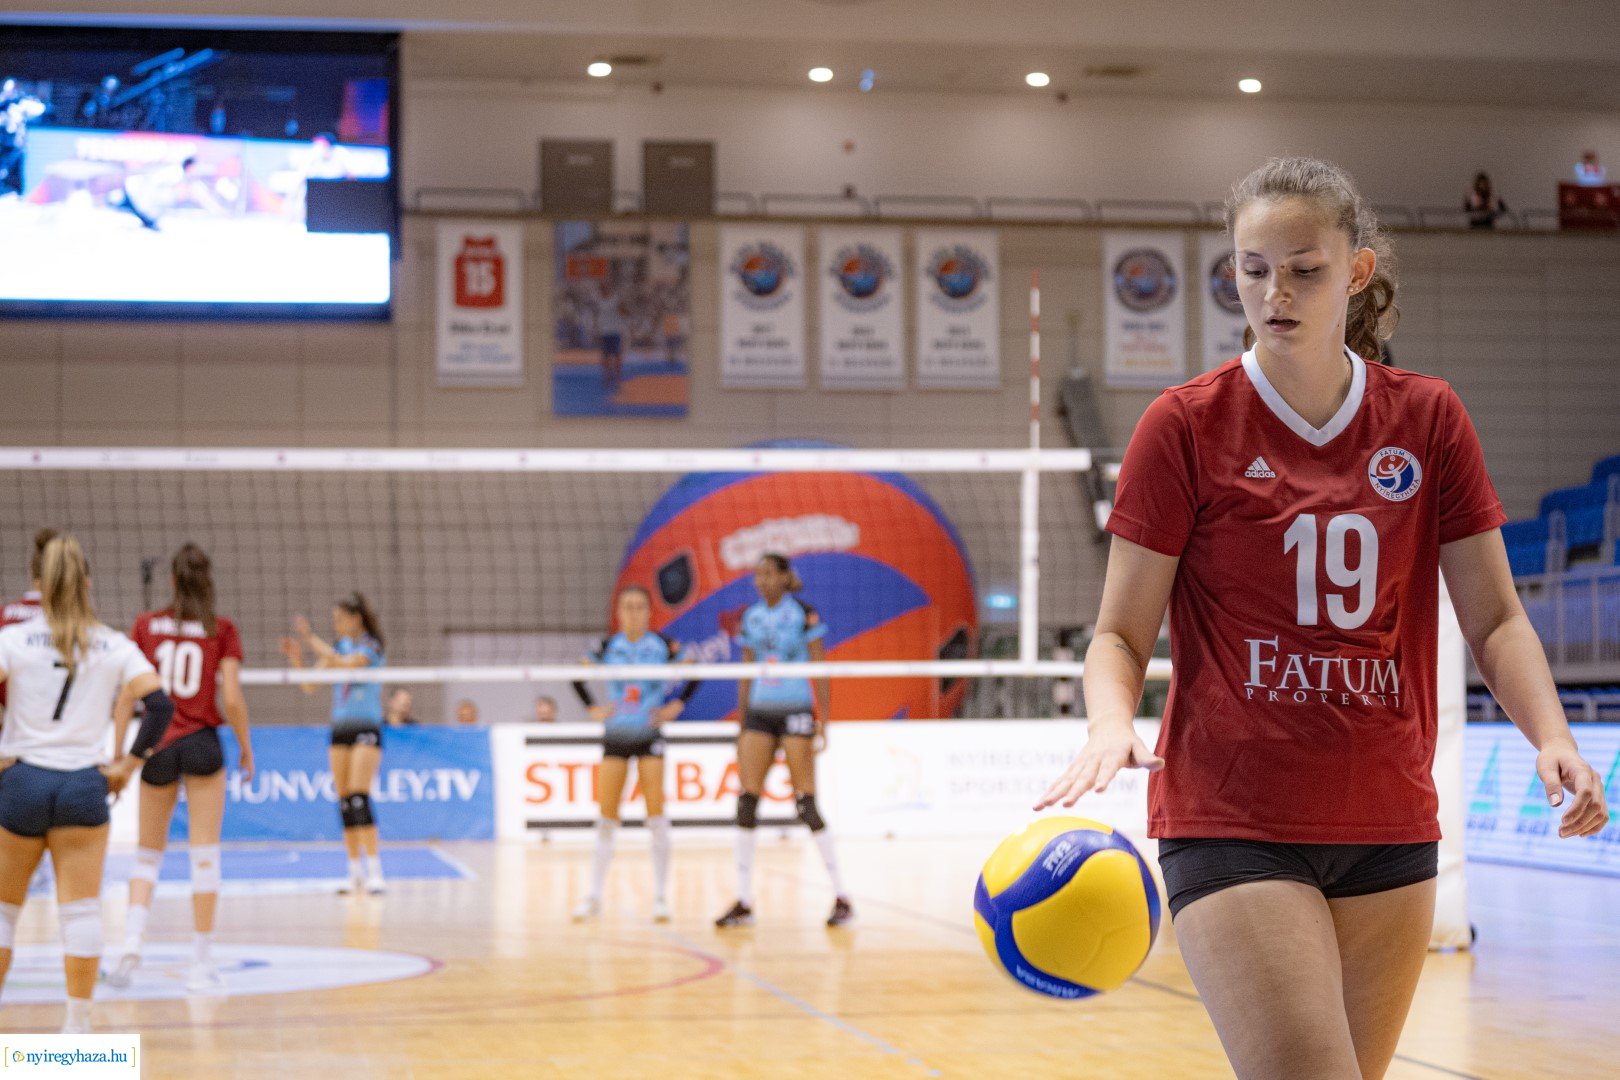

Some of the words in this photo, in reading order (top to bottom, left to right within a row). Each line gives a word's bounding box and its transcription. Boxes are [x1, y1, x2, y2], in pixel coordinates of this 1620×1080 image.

[1244, 469, 1276, 479] adidas
[1380, 449, 1405, 457] FATUM
[1283, 513, 1379, 630] 19
[53, 659, 79, 721] 7
[155, 639, 204, 699] 10
[1244, 635, 1399, 694] FATUM
[226, 768, 481, 803] HUNVOLEY.TV
[524, 761, 797, 804] STBAG
